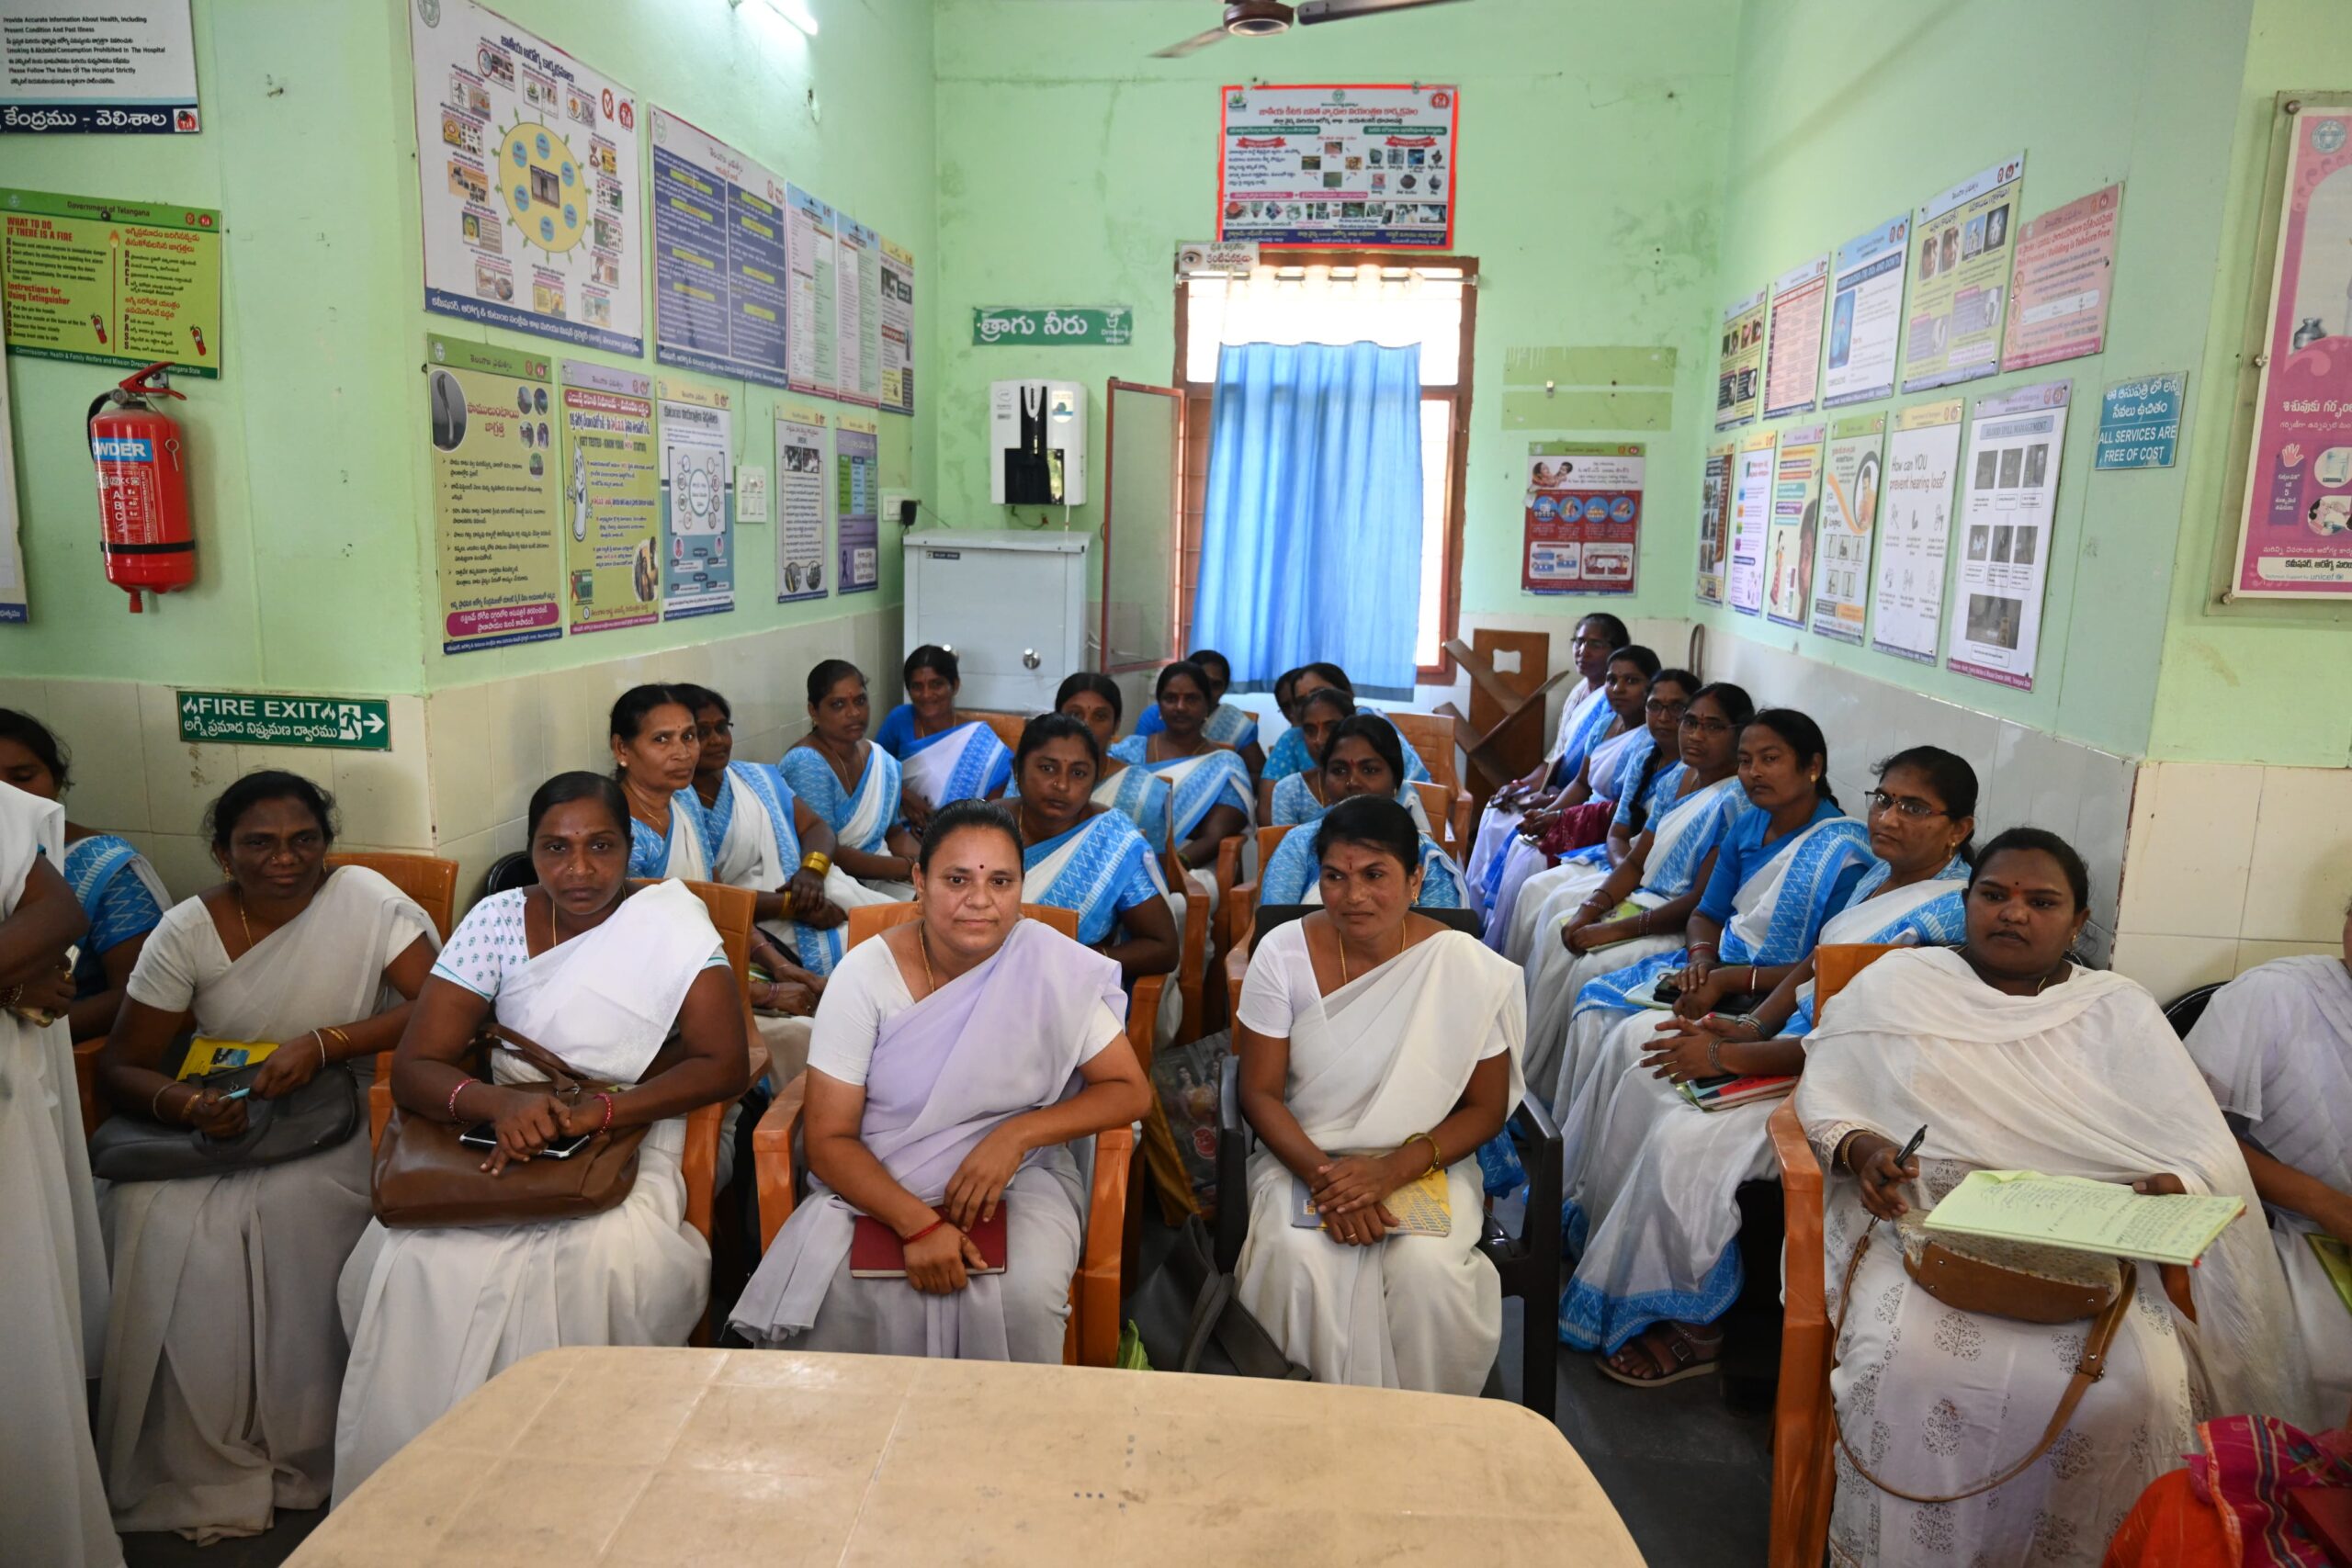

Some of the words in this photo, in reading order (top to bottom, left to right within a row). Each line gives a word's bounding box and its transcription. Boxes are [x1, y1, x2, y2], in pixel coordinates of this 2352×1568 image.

[4, 107, 76, 130] కేంద్రము
[96, 109, 166, 127] వెలిశాల
[67, 201, 107, 211] Government
[117, 206, 150, 217] Telangana
[7, 217, 28, 226] WHAT
[31, 219, 40, 228] TO
[42, 220, 51, 230] DO
[7, 227, 14, 235] IF
[17, 228, 37, 238] THERE
[40, 230, 47, 239] IS
[50, 231, 54, 239] A
[57, 231, 73, 242] FIRE
[2098, 230, 2110, 240] Free
[7, 282, 49, 294] Instructions
[51, 286, 61, 294] for
[7, 291, 26, 301] Using
[28, 293, 70, 304] Extinguisher
[980, 315, 1035, 342] త్రాగు
[1044, 311, 1088, 335] నీరు
[2107, 389, 2117, 400] ఈ
[2118, 384, 2148, 400] ఆసుపత్రి
[2150, 378, 2162, 394] లో
[2164, 379, 2180, 396] అన్ని
[2112, 403, 2135, 418] సేవలు
[2137, 400, 2168, 416] ఉచితం
[2283, 400, 2320, 413] శిశువుకు
[1985, 426, 2000, 437] BLOOD
[2001, 424, 2013, 435] SPILL
[2014, 421, 2048, 434] MANAGEMENT
[2098, 432, 2112, 444] ALL
[2115, 427, 2156, 443] SERVICES
[2158, 425, 2177, 439] ARE
[2104, 448, 2125, 462] FREE
[2126, 447, 2139, 460] OF
[2140, 446, 2165, 460] COST
[1892, 456, 1902, 471] How
[1903, 460, 1913, 471] can
[1915, 454, 1928, 470] YOU
[1889, 477, 1909, 492] prevent
[1911, 476, 1929, 493] hearing
[1931, 470, 1946, 489] loss?
[113, 491, 121, 499] A
[114, 502, 122, 510] B
[115, 512, 123, 521] C
[198, 698, 256, 716] FIRE
[265, 701, 322, 718] EXIT
[185, 715, 208, 737] అగ్ని
[208, 719, 244, 736] ప్రమాద
[293, 725, 337, 741] ద్వారము
